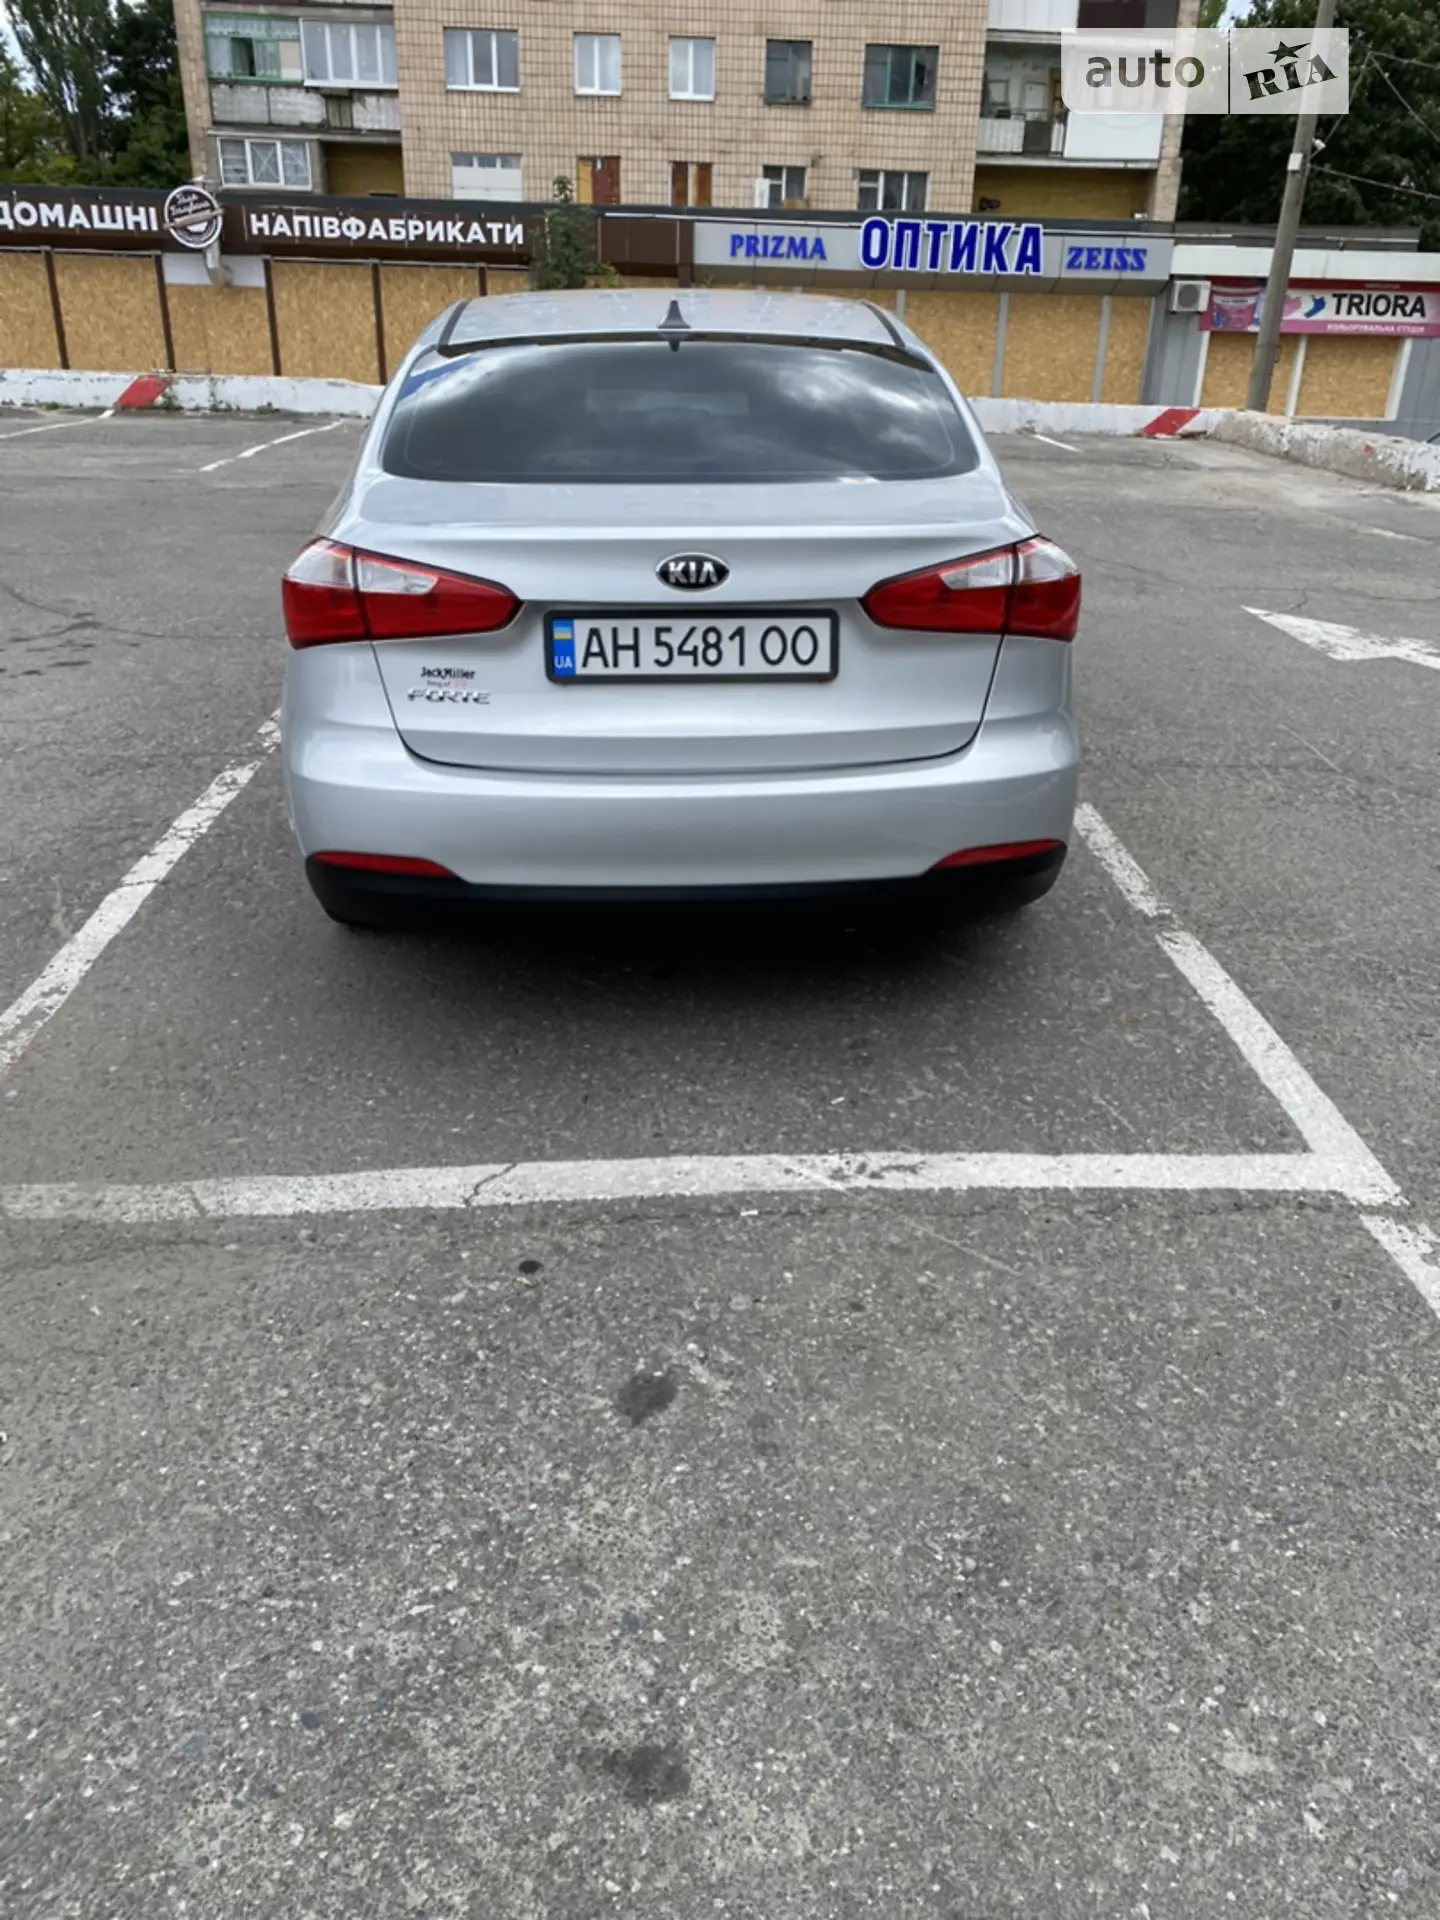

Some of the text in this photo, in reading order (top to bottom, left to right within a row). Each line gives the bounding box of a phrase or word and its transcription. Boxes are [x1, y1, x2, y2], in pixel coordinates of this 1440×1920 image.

[0, 200, 158, 231] ДОМАШНІ
[250, 213, 523, 244] НАПІВФАБРИКАТИ
[729, 233, 827, 261] PRIZMA
[860, 216, 1043, 275] ОПТИКА
[1066, 246, 1147, 272] ZEISS
[1332, 293, 1426, 317] TRIORA
[668, 561, 718, 583] KIA
[581, 627, 640, 668] AH
[653, 626, 746, 667] 5481
[554, 656, 573, 669] UA
[408, 689, 490, 705] FORTE
